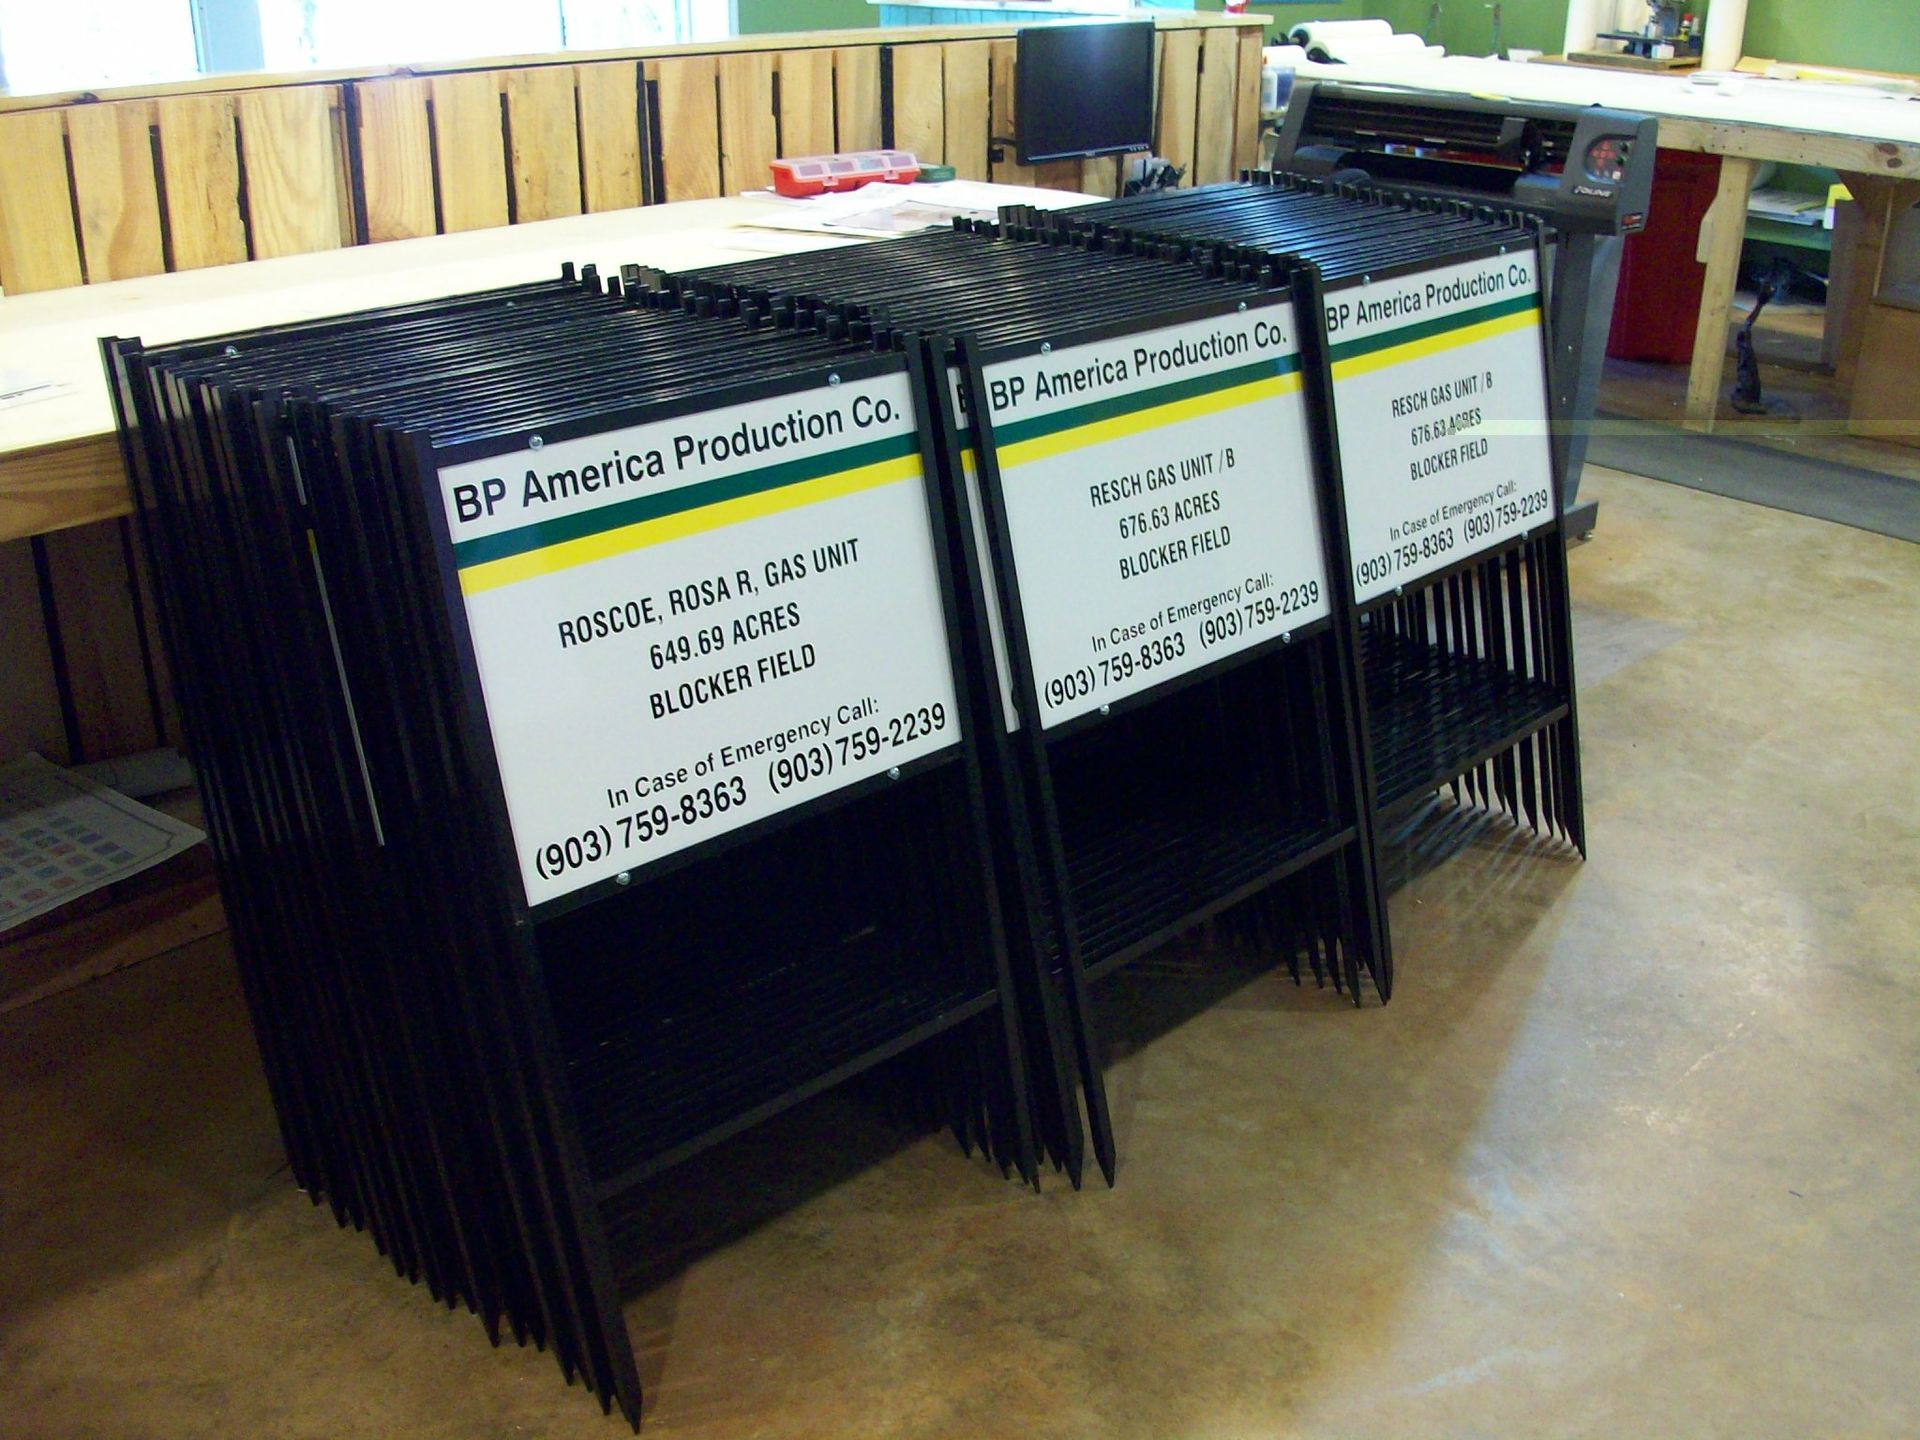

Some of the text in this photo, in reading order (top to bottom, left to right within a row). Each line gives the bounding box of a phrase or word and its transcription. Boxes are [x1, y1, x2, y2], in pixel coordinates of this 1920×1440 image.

[1326, 264, 1530, 333] BP America Production Co.
[990, 377, 1024, 411] BP
[1036, 358, 1128, 401] America
[1134, 331, 1248, 376] Production
[1255, 322, 1286, 348] Co.
[1392, 391, 1427, 417] RESCH
[1431, 384, 1451, 405] GAS
[1455, 376, 1477, 398] UNIT
[453, 478, 505, 523] BP
[523, 450, 664, 507] America
[674, 410, 842, 470] Production
[853, 396, 899, 428] Co.
[1411, 438, 1487, 480] BLOCKER FIELD
[1412, 408, 1481, 446] 676.63 ACRES
[1090, 474, 1141, 507] RESCH
[1147, 464, 1176, 490] GAS
[1180, 453, 1212, 481] UNIT
[1390, 480, 1516, 541] In Case of Emergency Call:
[1120, 491, 1220, 539] 676.63 ACRES
[1120, 526, 1230, 579] BLOCKER FIELD
[559, 538, 858, 648] ROSCOE, ROSA R, GAS UNIT
[1092, 573, 1273, 652] In Case of Emergency Call:
[650, 602, 800, 669] 649.69 ACRES
[650, 644, 815, 719] BLOCKER FIELD
[608, 697, 878, 808] In Case of Emergency Call:
